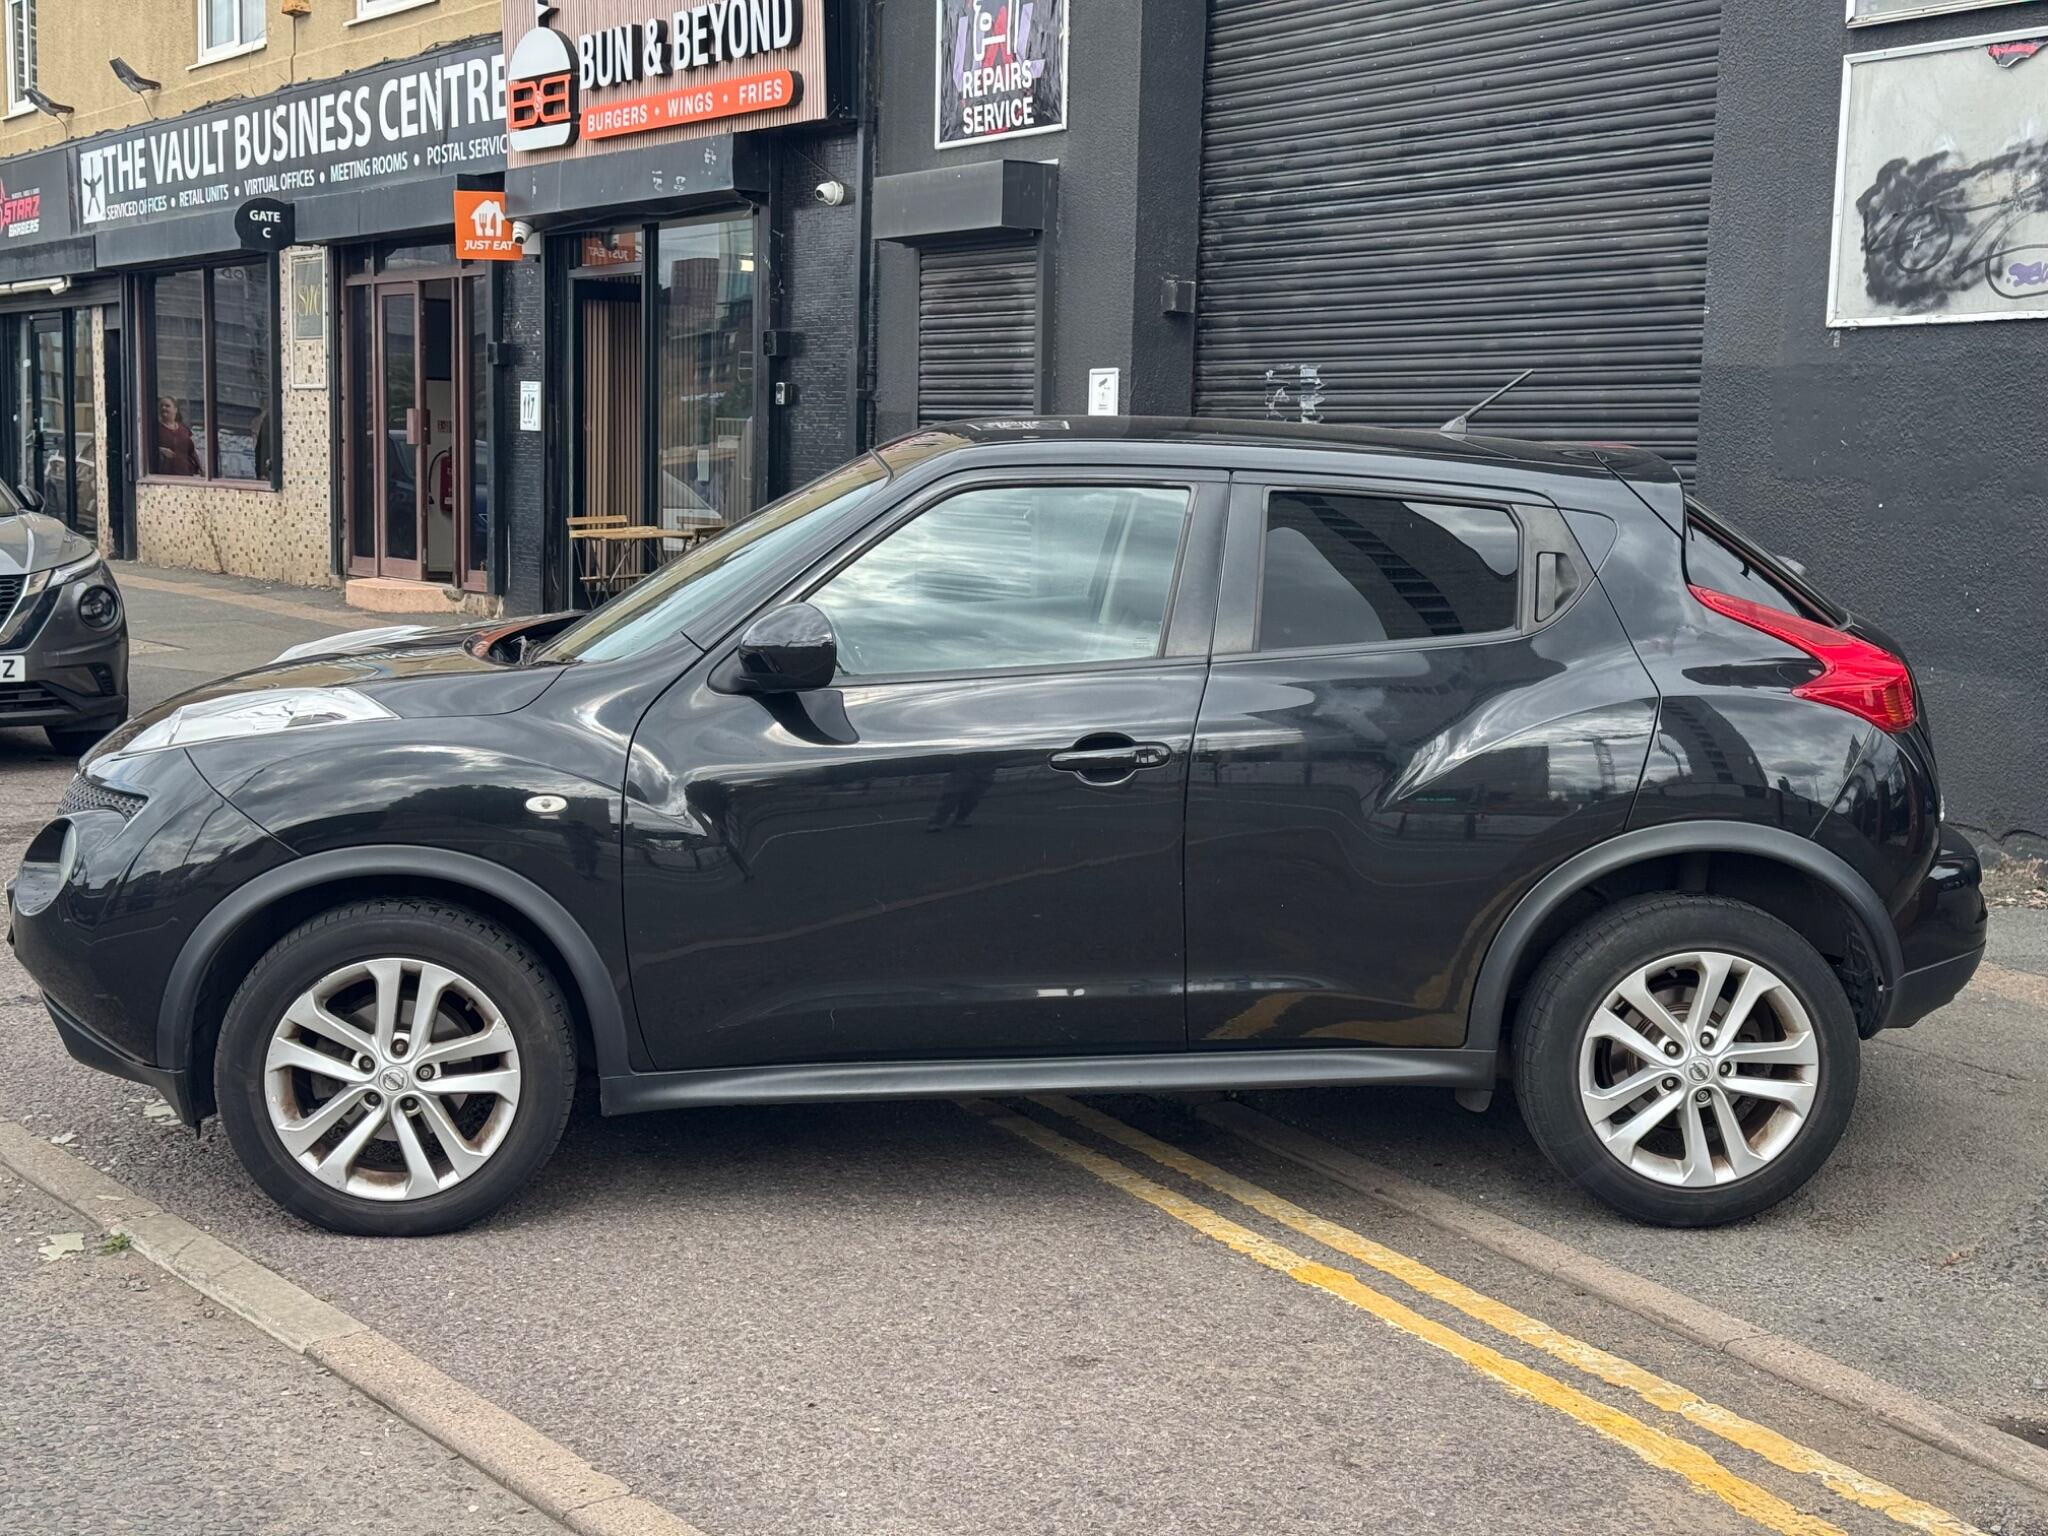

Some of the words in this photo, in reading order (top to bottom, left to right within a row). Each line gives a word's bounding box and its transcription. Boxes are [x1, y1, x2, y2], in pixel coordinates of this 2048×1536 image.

[579, 23, 633, 90] BUN
[642, 18, 663, 77] &
[673, 0, 793, 71] BEYOND
[962, 59, 1032, 99] REPAIRS
[102, 138, 147, 194] THE
[150, 118, 228, 185] VAULT
[234, 85, 372, 170] BUSINESS
[378, 53, 508, 142] CENTRE
[587, 103, 648, 133] BURGERS
[667, 91, 714, 118] WINGS
[738, 78, 783, 106] FRIES
[962, 96, 1035, 134] SERVICE
[106, 203, 138, 220] SERVICED
[179, 189, 205, 208] RETAIL
[205, 184, 230, 205] UNITS
[244, 176, 279, 196] VIRTUAL
[280, 169, 315, 189] OFFICES
[330, 156, 371, 183] MEETING
[372, 150, 408, 174] ROOMS
[427, 144, 467, 166] POSTAL
[4, 194, 40, 224] STARZ
[249, 209, 281, 223] GATE
[262, 227, 271, 238] C
[464, 240, 491, 251] JUST
[493, 241, 514, 251] EAT
[2, 660, 16, 678] Z
